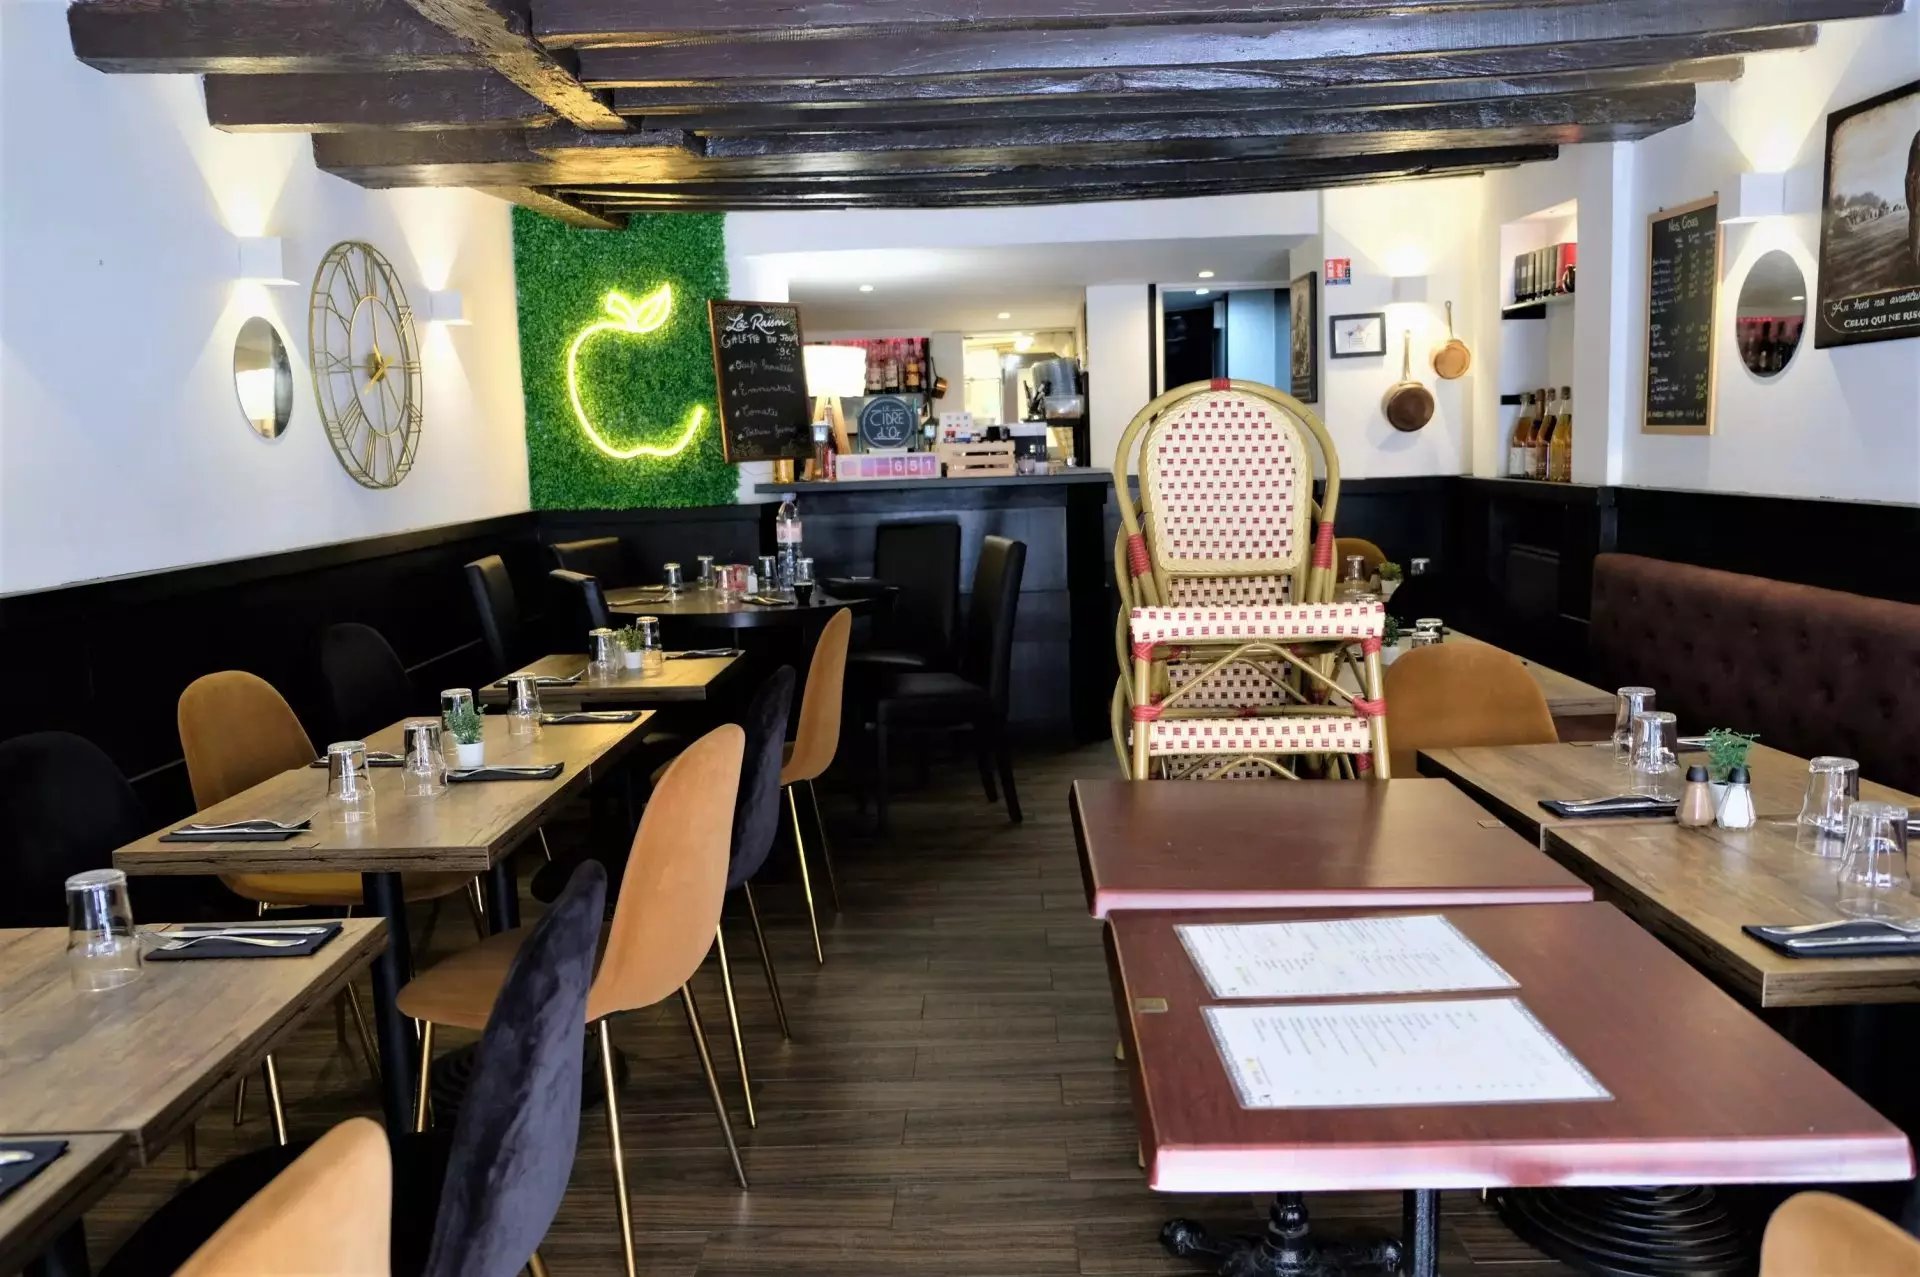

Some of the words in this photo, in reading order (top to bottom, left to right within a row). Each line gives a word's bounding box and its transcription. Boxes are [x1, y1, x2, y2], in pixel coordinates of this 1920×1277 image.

[750, 313, 789, 335] Raison
[1844, 318, 1869, 328] CELUI
[1871, 314, 1887, 326] QUI
[1888, 312, 1901, 322] NE
[722, 333, 761, 348] GALETTE
[766, 335, 777, 344] DU
[780, 333, 799, 346] JOUR
[870, 409, 905, 427] CIDRE
